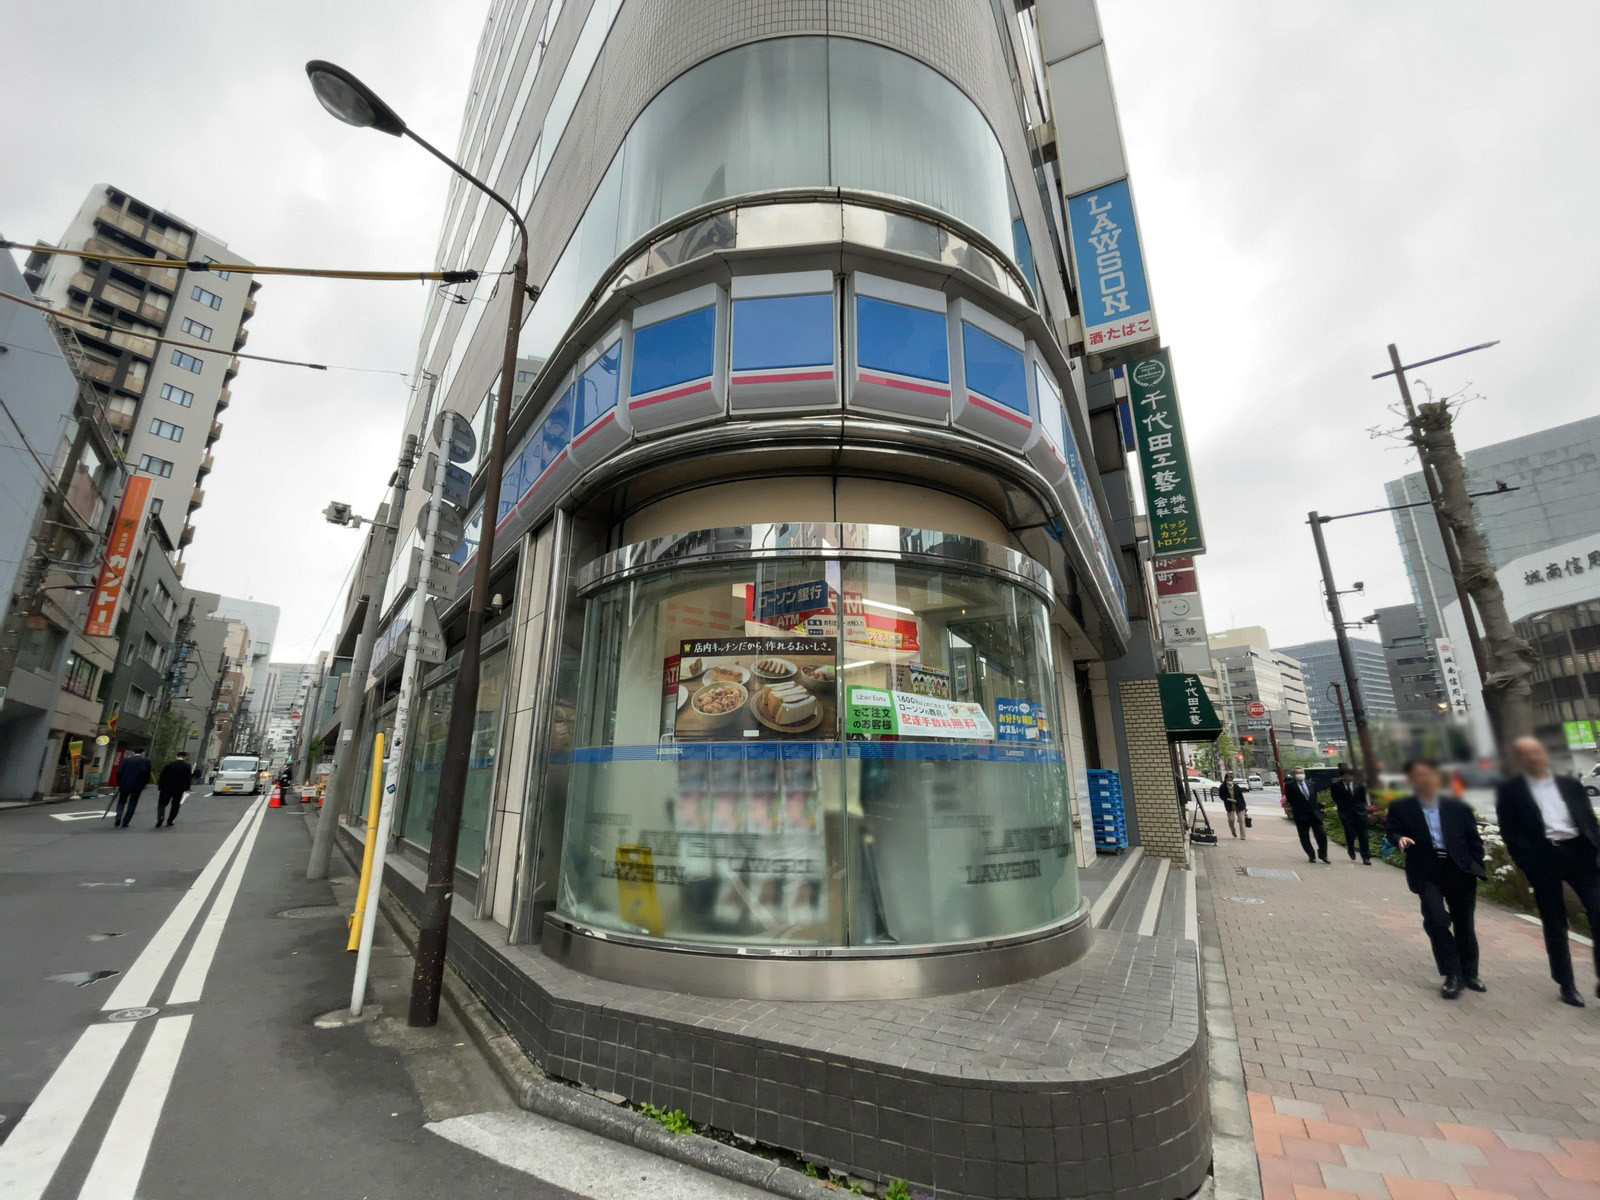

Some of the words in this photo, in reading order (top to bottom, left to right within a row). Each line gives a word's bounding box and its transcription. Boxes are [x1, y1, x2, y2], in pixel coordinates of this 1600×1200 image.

[1088, 195, 1131, 317] LAWSON
[97, 554, 128, 623] カントー
[757, 584, 823, 608] ローソン銀行
[776, 614, 800, 627] ATM
[664, 670, 679, 684] AT
[852, 707, 892, 719] でご注文
[901, 713, 977, 730] 配達手数料無料
[852, 719, 893, 731] のお客様
[965, 859, 1042, 885] LAWSON
